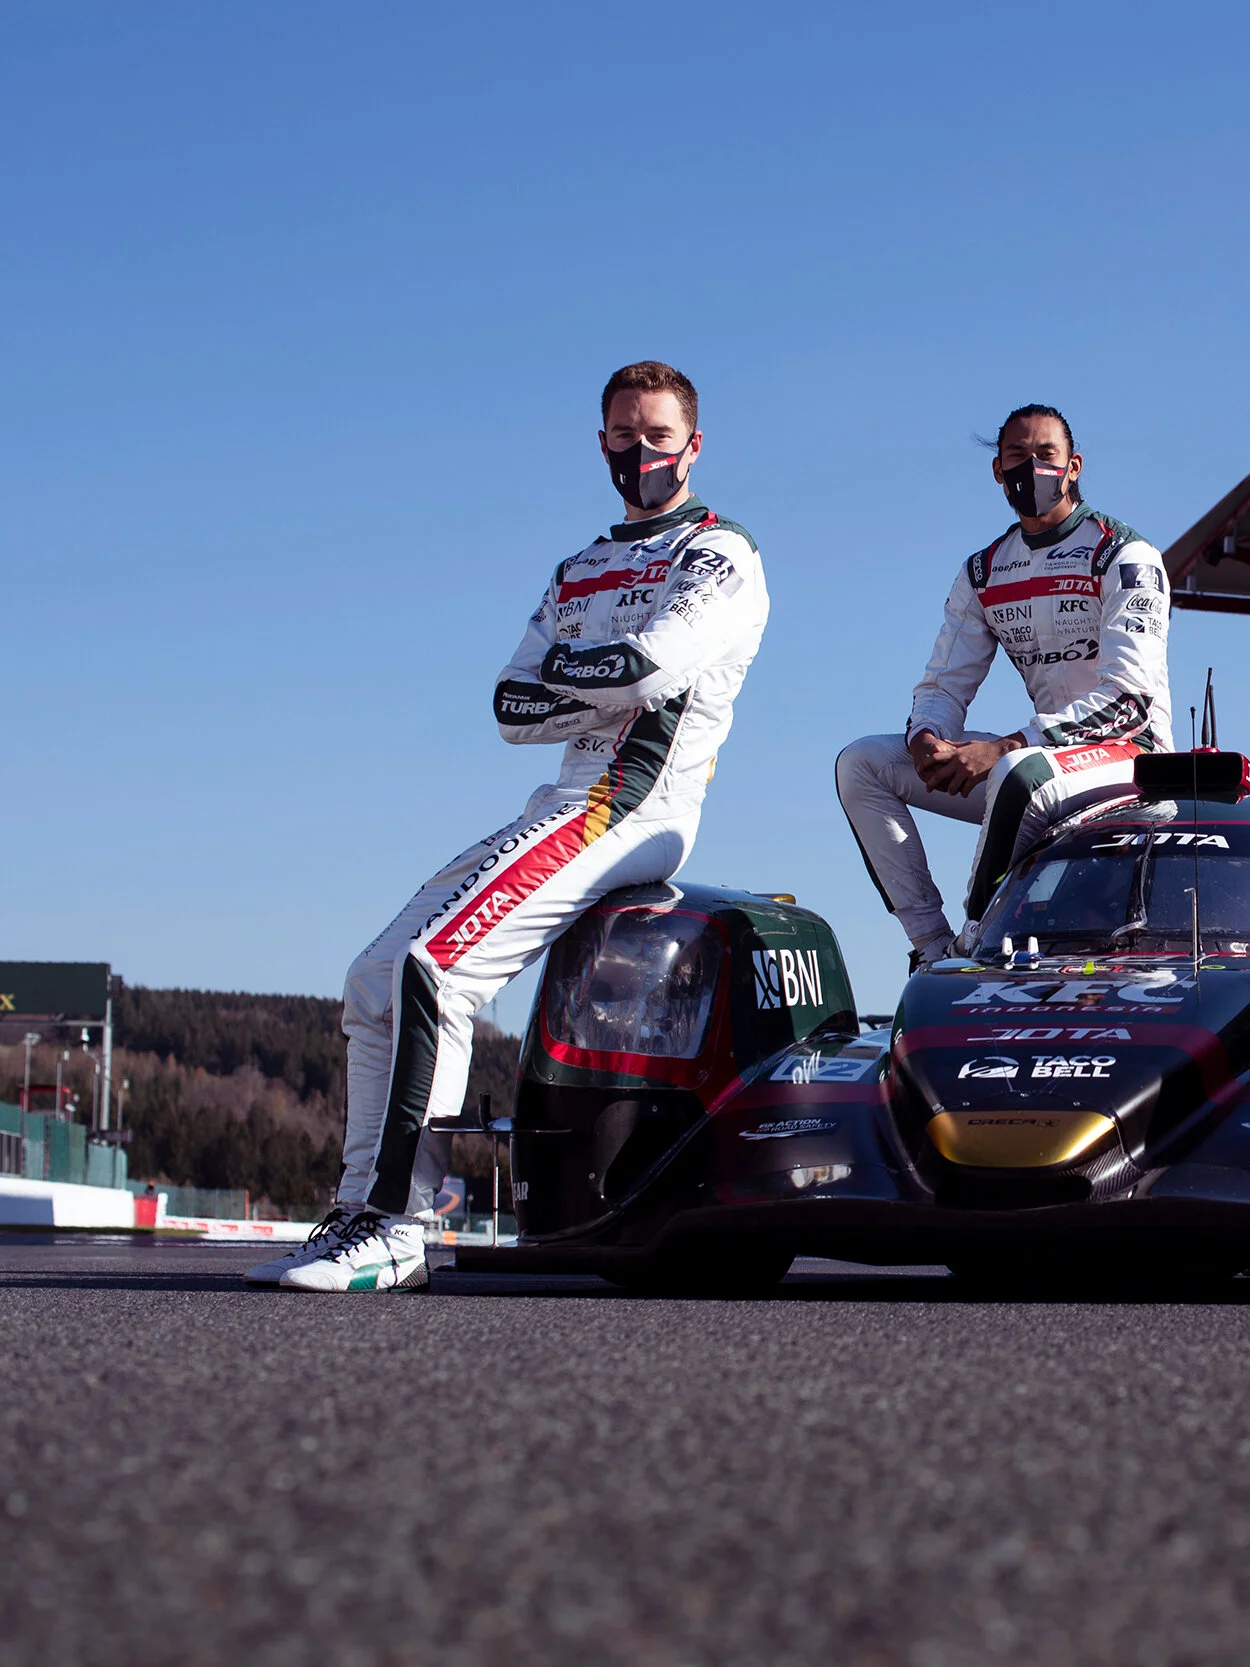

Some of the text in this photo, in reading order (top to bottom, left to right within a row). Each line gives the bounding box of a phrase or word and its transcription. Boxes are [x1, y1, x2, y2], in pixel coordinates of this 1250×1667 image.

[649, 460, 668, 470] JOTA
[992, 559, 1031, 573] OODYEAR
[1049, 579, 1094, 592] JOTA
[616, 589, 654, 607] KFC
[565, 598, 590, 618] BNI
[676, 596, 703, 620] TACO
[1006, 605, 1032, 621] BNI
[1058, 600, 1089, 613] KFC
[669, 604, 695, 631] BELL
[1010, 625, 1032, 635] TACO
[1064, 625, 1100, 635] NATURE
[1014, 634, 1034, 643] BELL
[1065, 713, 1129, 745] TURBO
[575, 738, 606, 754] S.V.
[1066, 748, 1111, 767] JOTA
[1091, 832, 1230, 850] JOTA
[446, 890, 512, 959] JOTA
[780, 949, 824, 1009] BNI
[952, 980, 1197, 1005] KFC
[968, 1005, 1162, 1014] INDONESIA
[966, 1028, 1132, 1041] JOTA
[1031, 1055, 1118, 1067] TACO
[1031, 1066, 1111, 1079] BELL
[775, 1118, 822, 1127] ACTION
[394, 1229, 411, 1237] KFC
